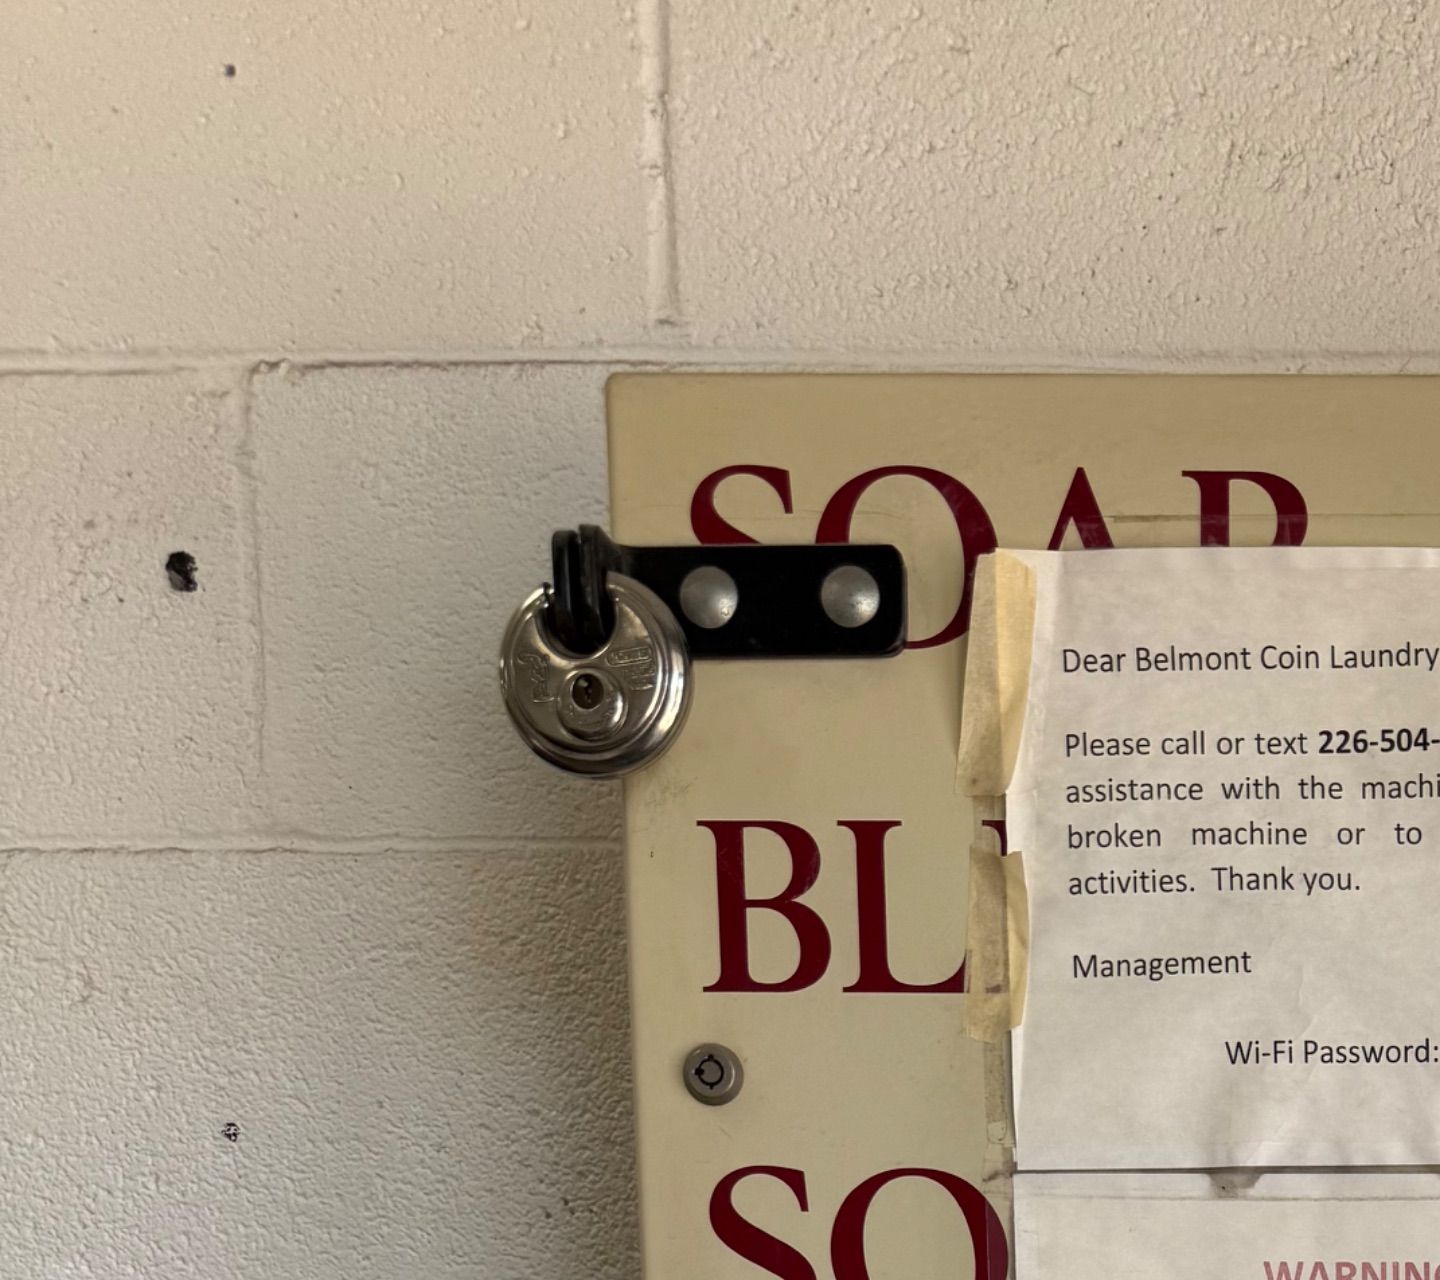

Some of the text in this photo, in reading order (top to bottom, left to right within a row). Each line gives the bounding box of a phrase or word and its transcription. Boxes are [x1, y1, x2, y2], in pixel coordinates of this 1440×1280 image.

[1063, 649, 1126, 672] Dear
[1136, 645, 1251, 671] Belmont
[1261, 645, 1319, 669] Coin
[1331, 641, 1439, 671] Laundry
[1066, 732, 1150, 757] Please
[1161, 730, 1204, 755] call
[1217, 737, 1245, 755] or
[1254, 733, 1308, 754] text
[1066, 778, 1203, 803] assistance
[1221, 776, 1279, 799] with
[1298, 775, 1342, 799] the
[1068, 823, 1160, 849] broken
[1192, 821, 1307, 845] machine
[1338, 828, 1365, 845] or
[1394, 824, 1422, 844] to
[1069, 866, 1359, 896] activities. Thank you.
[696, 820, 1006, 995] BL
[1073, 952, 1251, 981] Management
[1225, 1040, 1292, 1065] Wi-Fi
[1304, 1038, 1438, 1063] Password:
